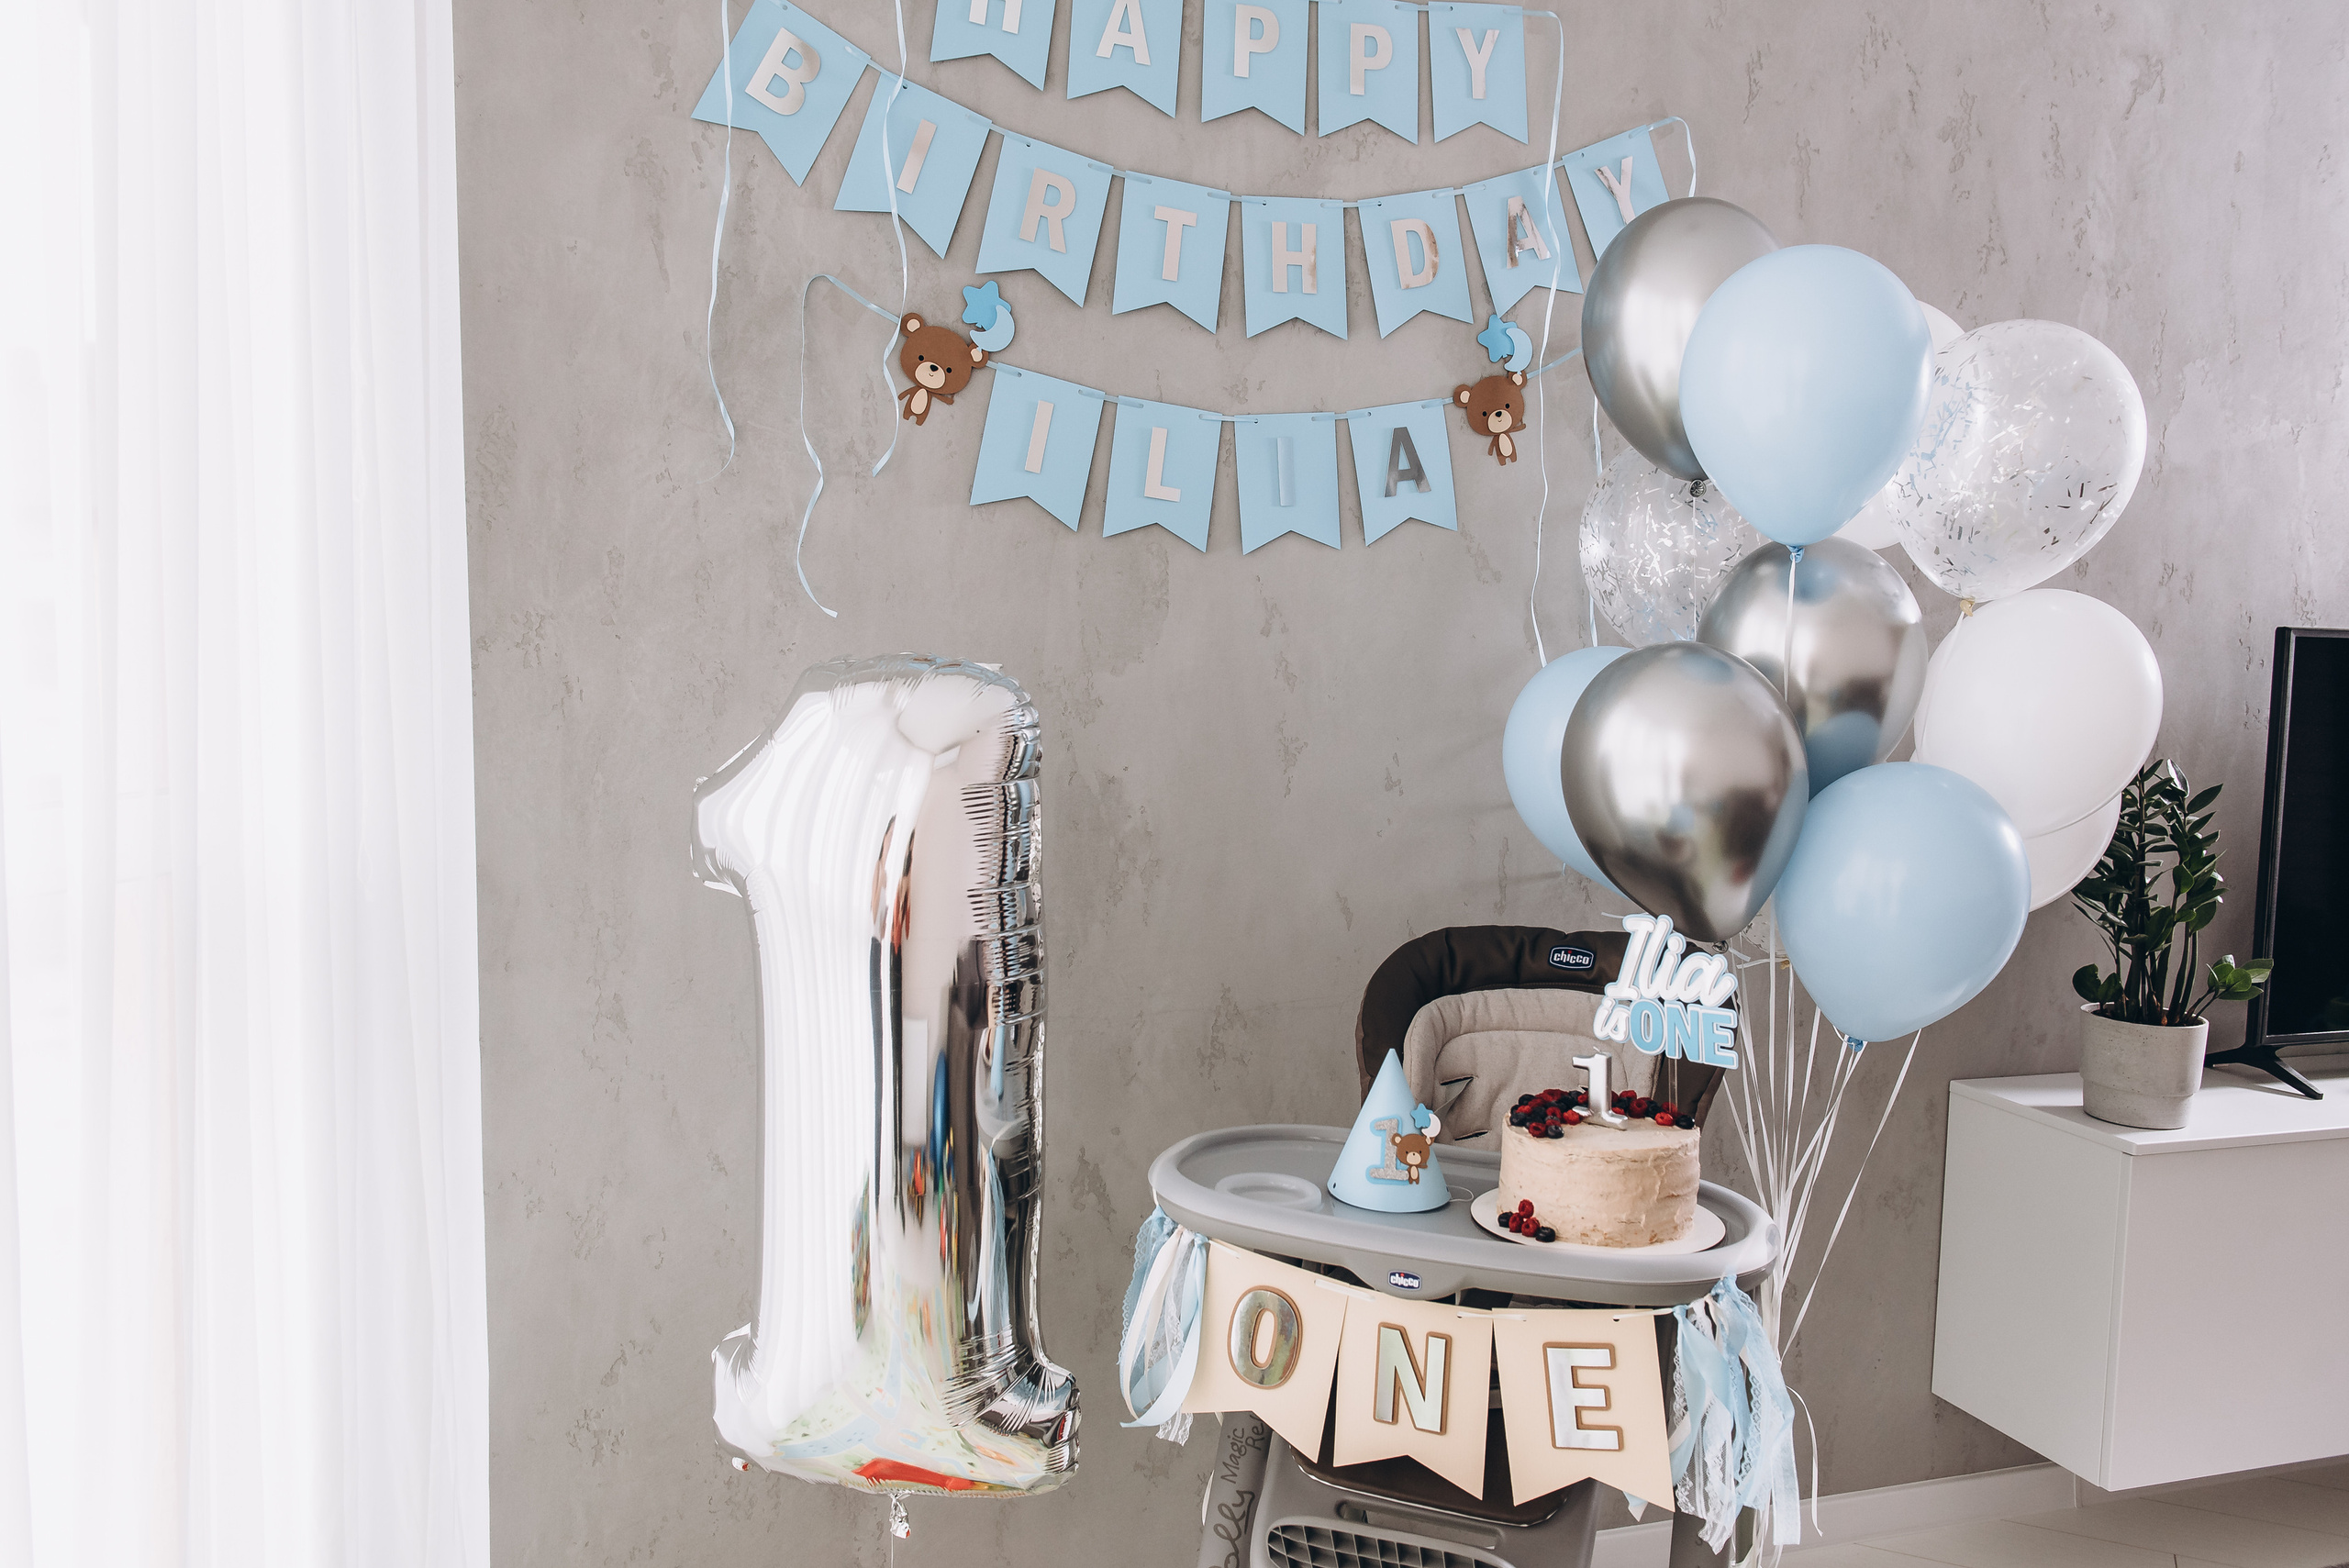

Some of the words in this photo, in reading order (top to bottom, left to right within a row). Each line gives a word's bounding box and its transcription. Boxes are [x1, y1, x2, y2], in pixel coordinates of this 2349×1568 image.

[744, 28, 1636, 294] BIRTHDAY
[1024, 400, 1431, 506] ILIA
[1553, 950, 1590, 965] chicco
[1604, 914, 1738, 1007] Ilia
[1593, 995, 1631, 1043] is
[1629, 998, 1738, 1070] ONE
[1390, 1272, 1419, 1288] chicco
[1226, 1284, 1625, 1451] ONE
[1220, 1428, 1247, 1485] Magic
[1208, 1490, 1255, 1568] olly
